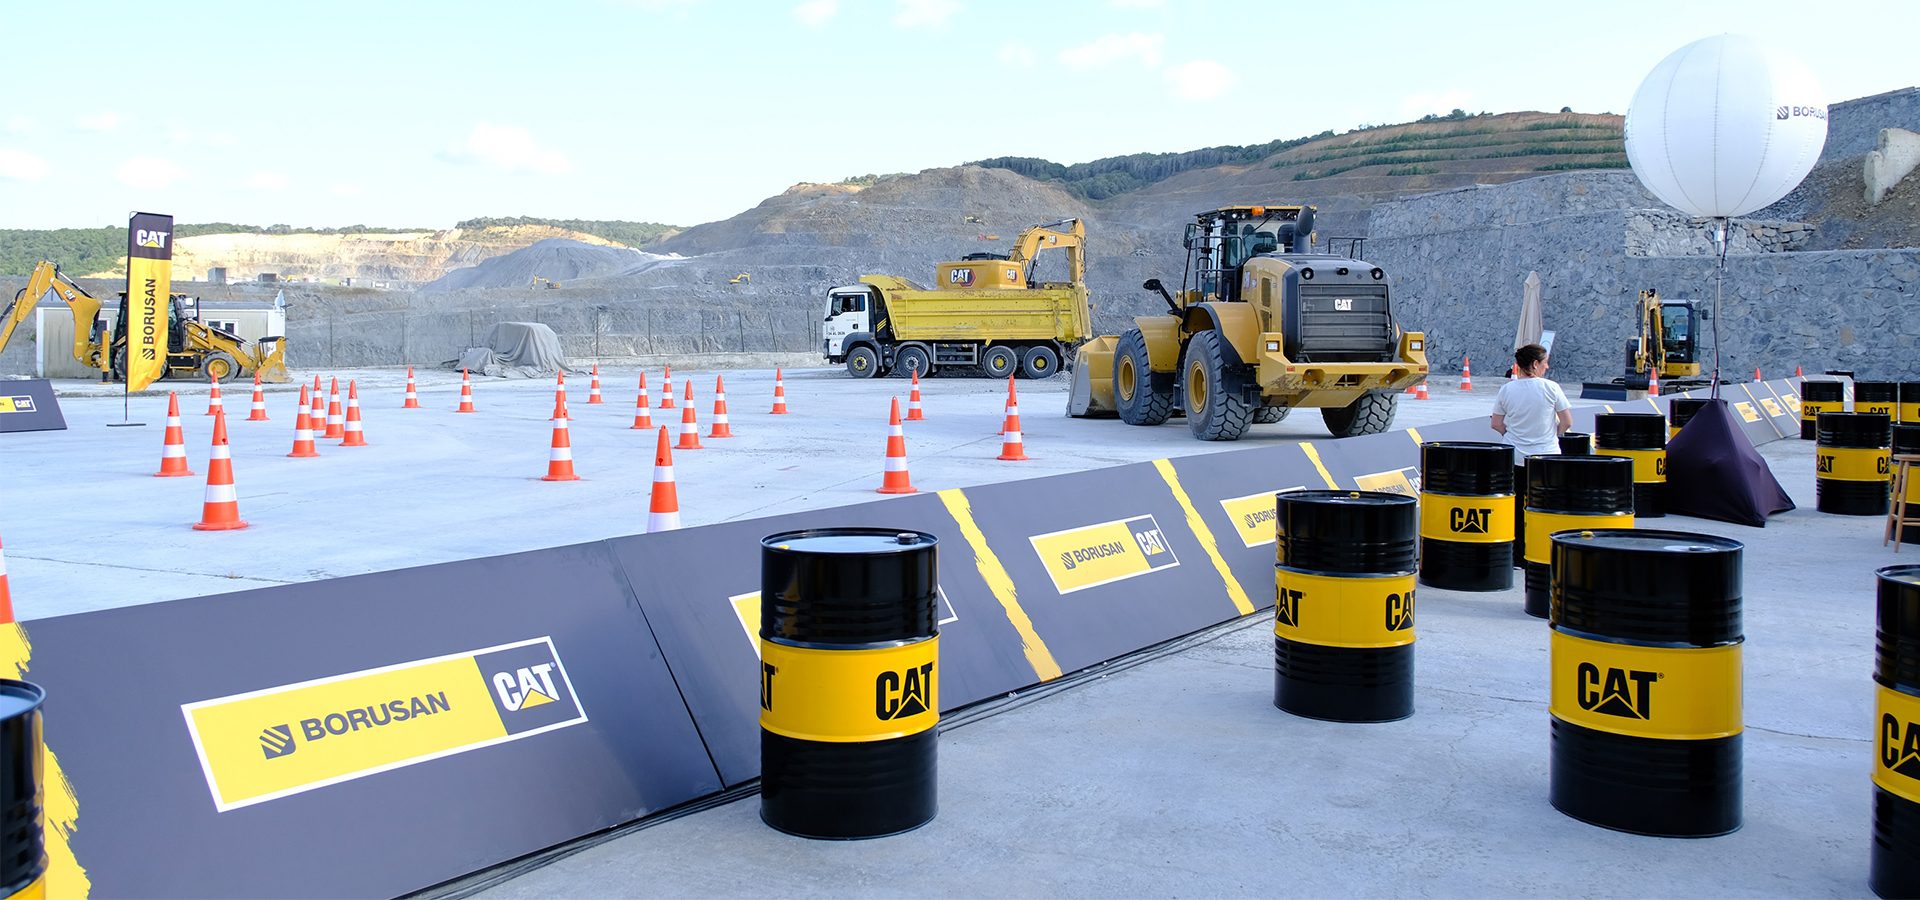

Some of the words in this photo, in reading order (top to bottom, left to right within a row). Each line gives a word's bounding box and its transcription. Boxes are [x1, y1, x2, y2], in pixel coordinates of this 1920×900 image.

[136, 229, 168, 248] CAT
[951, 269, 970, 283] CAT
[143, 279, 156, 345] BORUSAN
[1335, 299, 1353, 311] CAT
[14, 400, 31, 408] CAT
[1804, 405, 1821, 416] CAT
[1253, 507, 1277, 524] BORUS
[1450, 507, 1491, 533] CAT
[1073, 541, 1126, 563] BORUSAN
[1136, 529, 1166, 556] CAT
[300, 691, 451, 742] BORUSAN
[493, 663, 560, 712] CAT
[875, 661, 934, 721] CAT
[1577, 662, 1657, 721] CAT
[1881, 712, 1920, 781] CA
